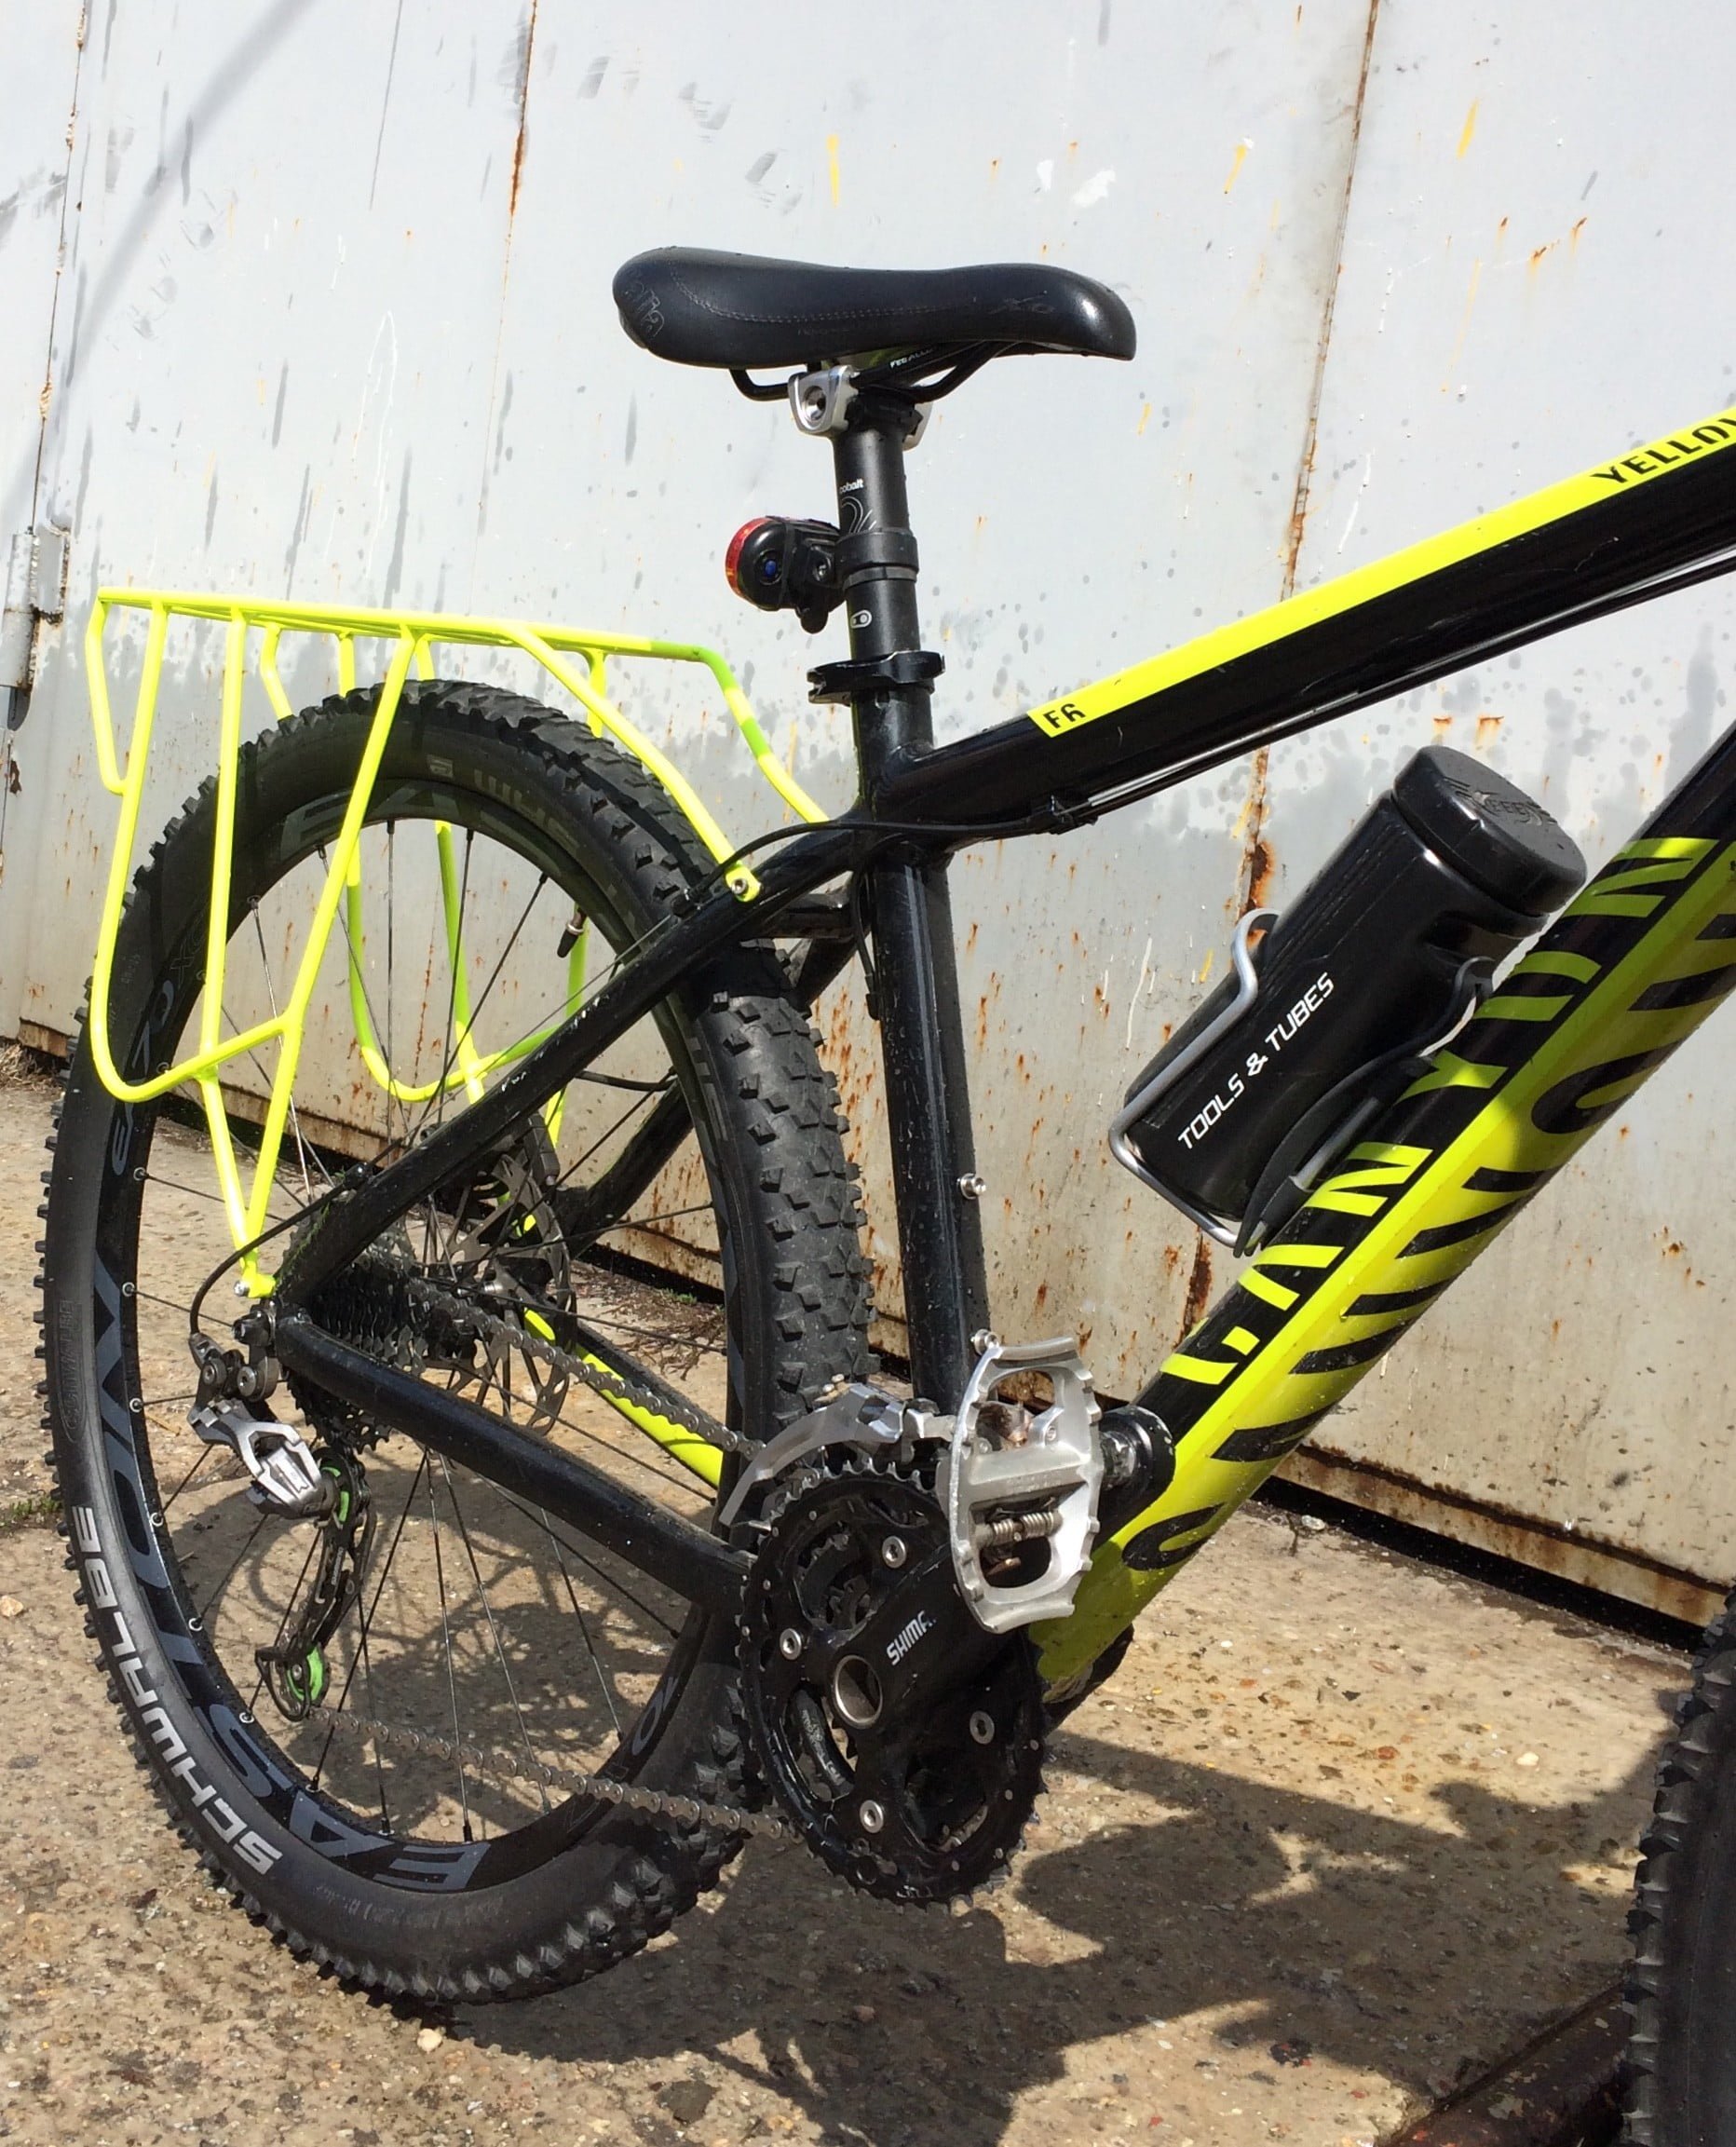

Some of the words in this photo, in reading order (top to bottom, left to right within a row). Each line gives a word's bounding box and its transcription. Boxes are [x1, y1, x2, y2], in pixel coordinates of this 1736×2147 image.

[1178, 1080, 1245, 1149] TOOLS
[1245, 1050, 1269, 1076] &
[1265, 972, 1336, 1054] TUBES
[72, 1505, 283, 1875] SCHWALBE
[94, 1251, 491, 1891] EASTON
